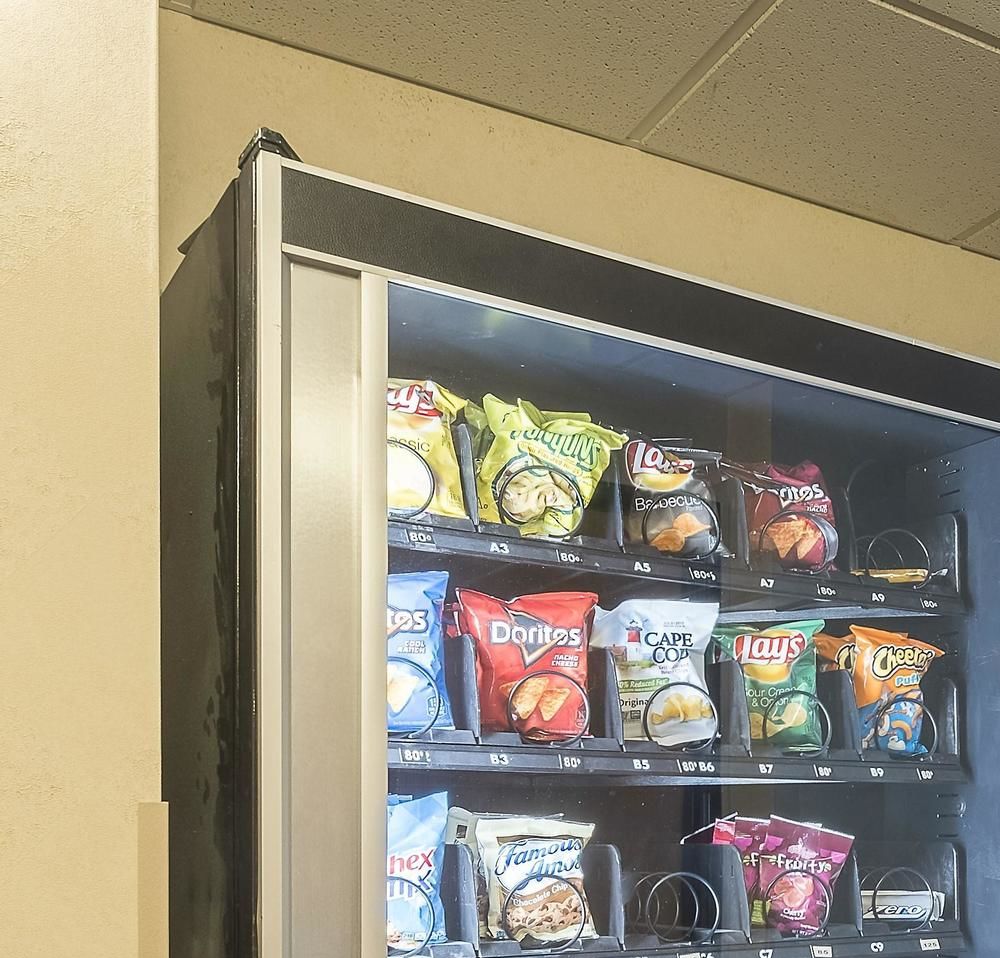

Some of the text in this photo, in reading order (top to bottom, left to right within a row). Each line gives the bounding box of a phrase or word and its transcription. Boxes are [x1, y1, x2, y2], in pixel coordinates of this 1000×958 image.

[489, 543, 509, 554] A3
[634, 562, 651, 573] A5
[760, 578, 775, 588] A7
[871, 593, 885, 603] A9
[489, 619, 584, 647] Doritos
[644, 632, 694, 647] CAPE
[739, 634, 806, 665] Lay's
[619, 698, 653, 708] Origina
[489, 754, 509, 765] B3
[633, 759, 650, 770] B5
[699, 762, 715, 773] B6
[759, 764, 774, 774] B7
[870, 767, 884, 777] B9
[495, 837, 583, 876] Famous
[871, 942, 884, 953] C9
